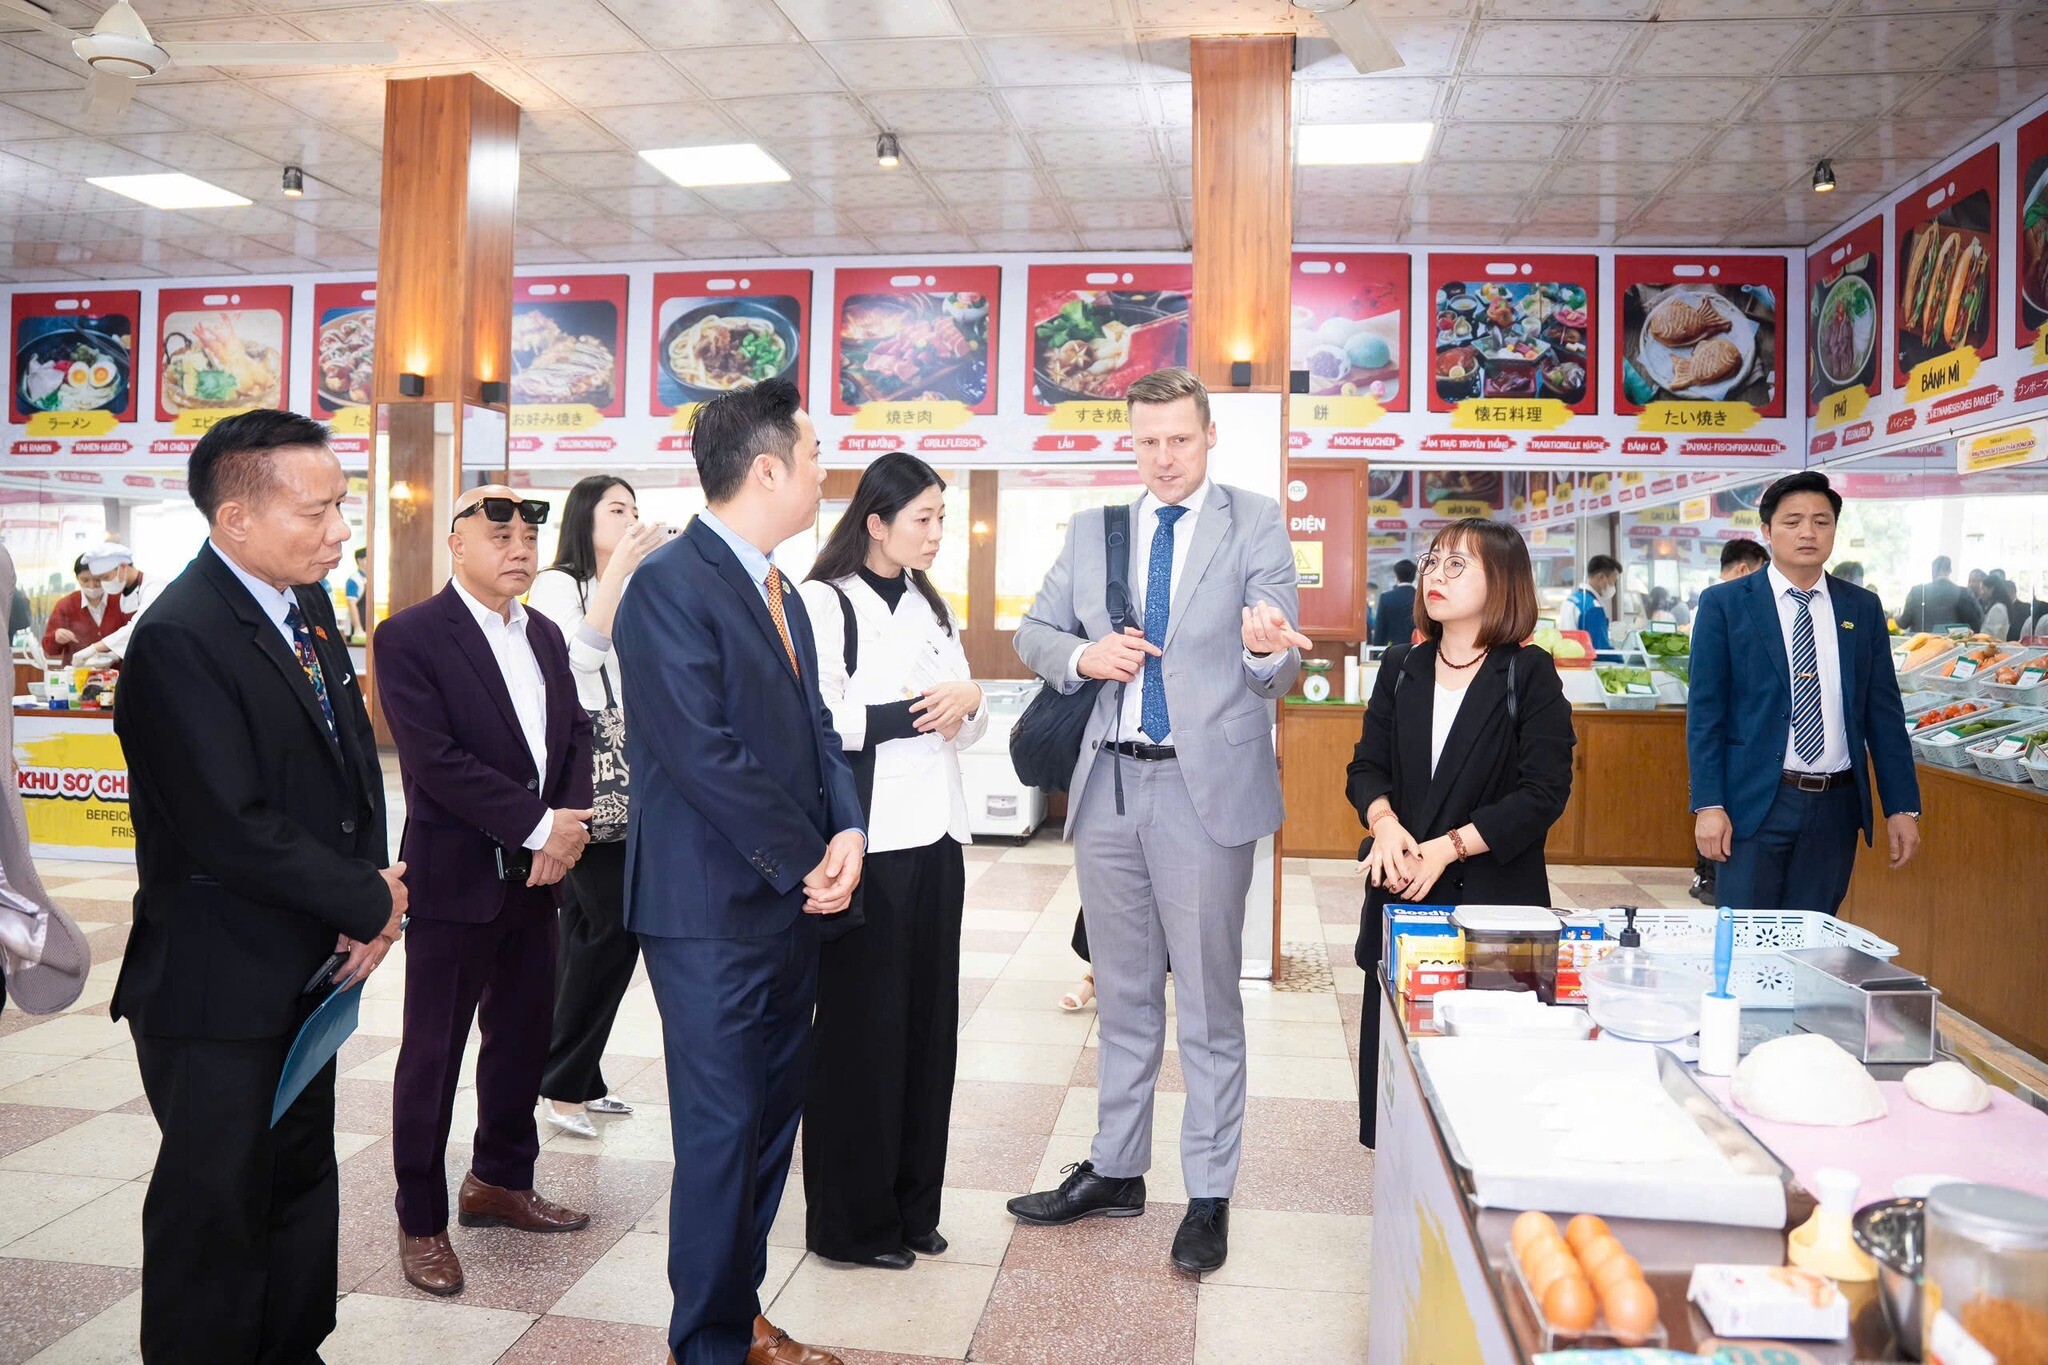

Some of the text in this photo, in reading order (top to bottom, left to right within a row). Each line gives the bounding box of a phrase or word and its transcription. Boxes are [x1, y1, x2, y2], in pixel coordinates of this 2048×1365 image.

[1921, 360, 1960, 392] BÁNH MÌ
[1972, 391, 1999, 409] BAGUETTE
[1833, 396, 1848, 420] PHỞ
[48, 417, 91, 431] ラーメン
[511, 411, 584, 427] お好み焼き
[886, 409, 933, 425] 焼き肉
[1664, 409, 1727, 427] たい焼き
[923, 437, 980, 448] GRILLFLEISCH
[1334, 436, 1396, 448] MOCHI-KUCHEN
[1531, 440, 1581, 450] TRADITIONELLE
[1627, 441, 1661, 451] BÁNH CÁ
[1686, 442, 1781, 454] TAIYAKI-FISCHFRIKADELLEN
[1291, 514, 1326, 534] ĐIỆN
[18, 771, 130, 794] KHU SƠ CH
[111, 826, 137, 839] FRIS
[1393, 908, 1454, 917] Goodb
